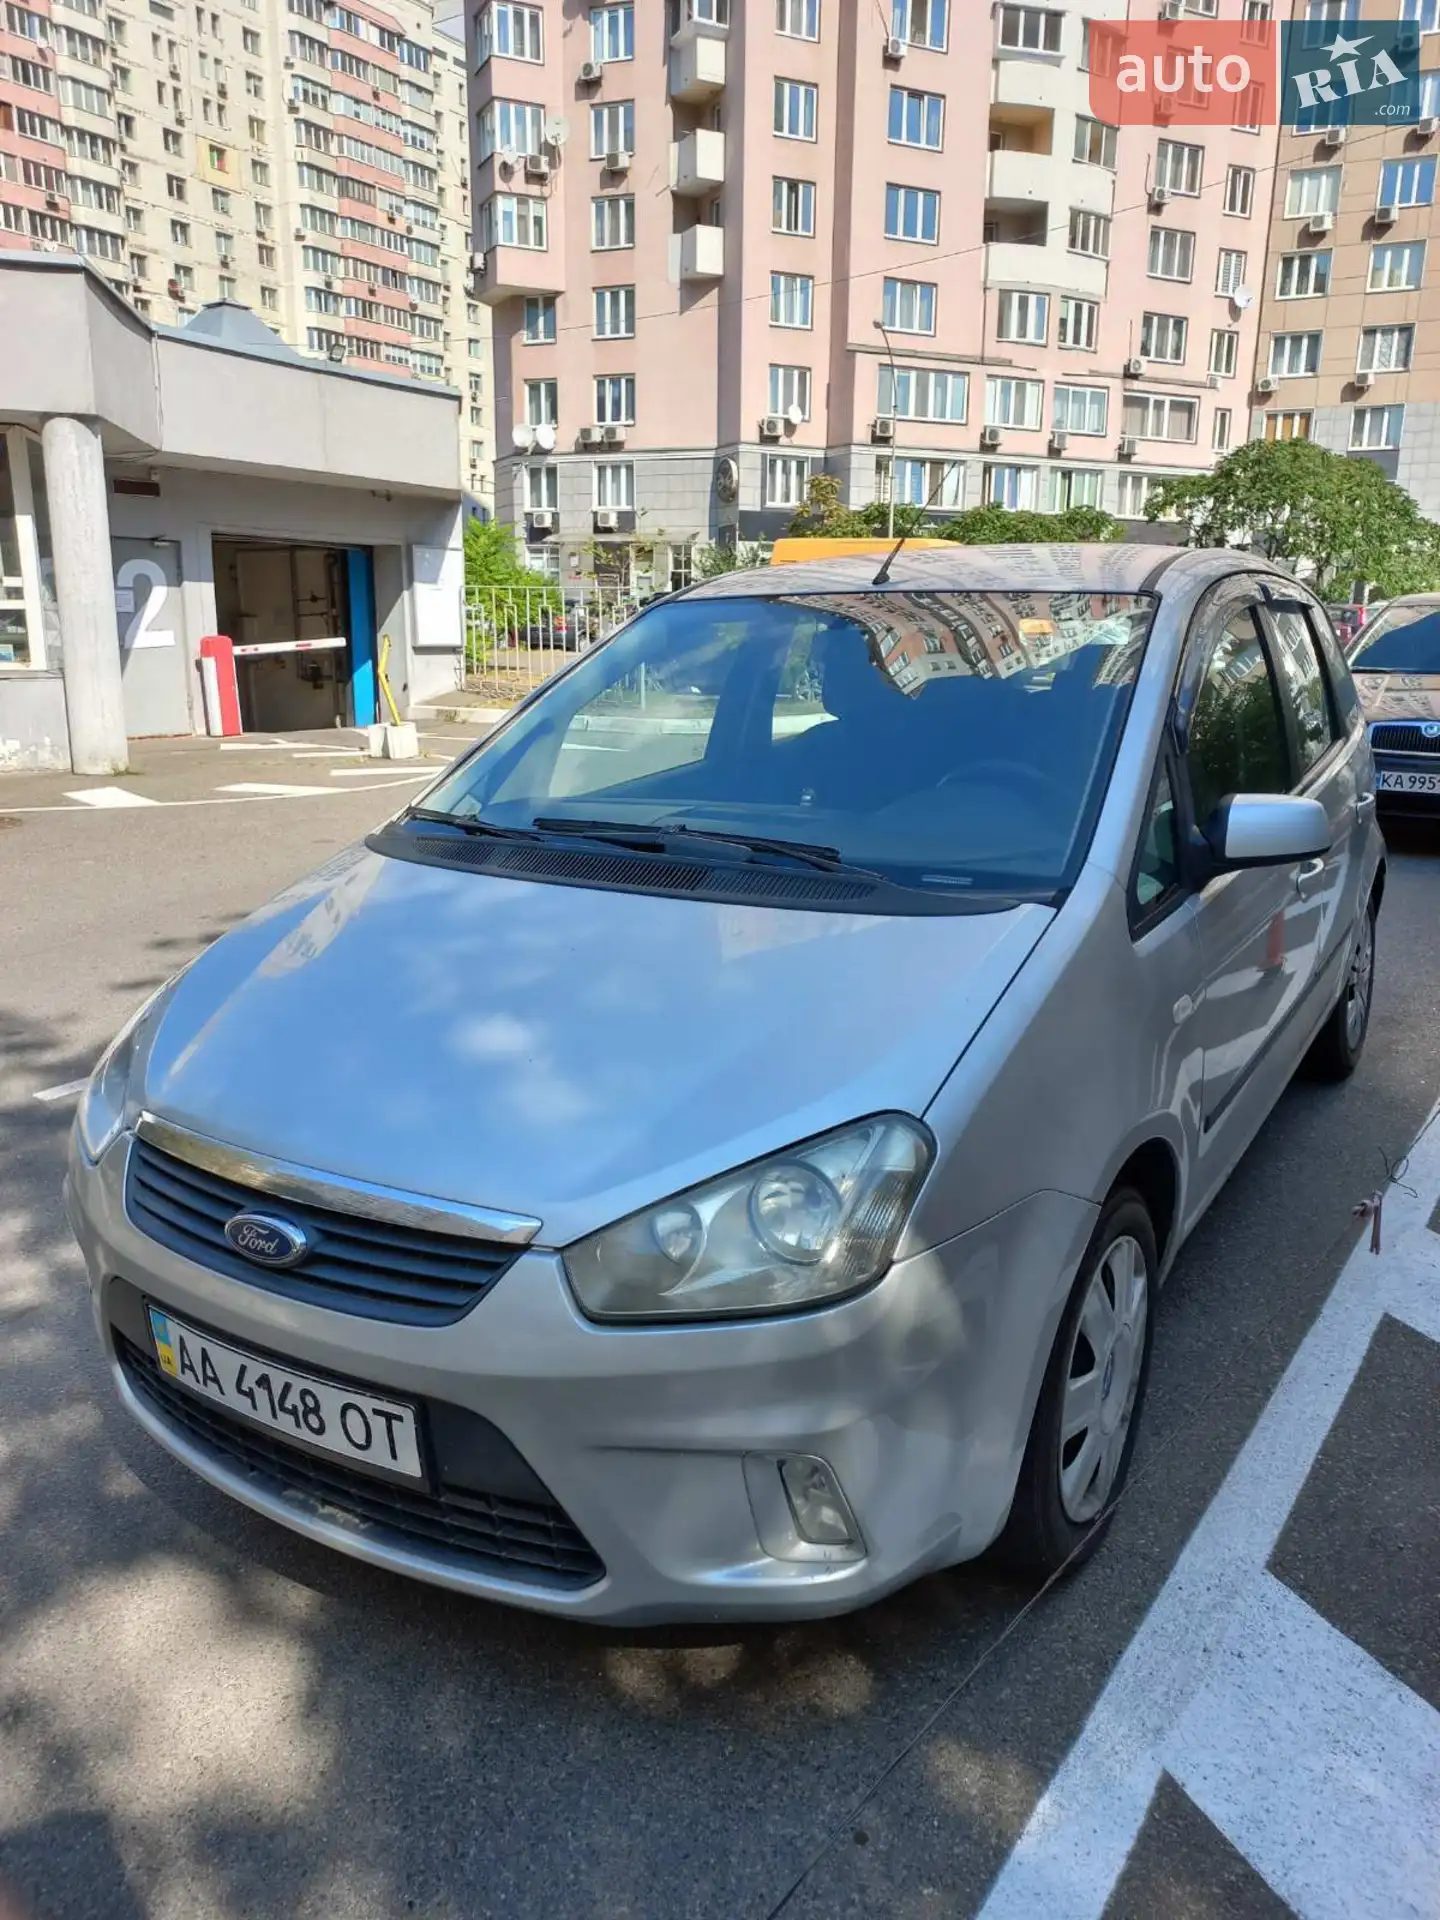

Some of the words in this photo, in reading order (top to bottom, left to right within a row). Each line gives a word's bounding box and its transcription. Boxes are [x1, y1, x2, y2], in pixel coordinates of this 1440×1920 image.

[117, 559, 176, 649] 2
[1381, 773, 1404, 789] KA
[1408, 775, 1440, 791] 995
[238, 1223, 279, 1255] Ford
[179, 1335, 225, 1396] AA
[235, 1363, 326, 1436] 4148
[340, 1402, 404, 1461] OT
